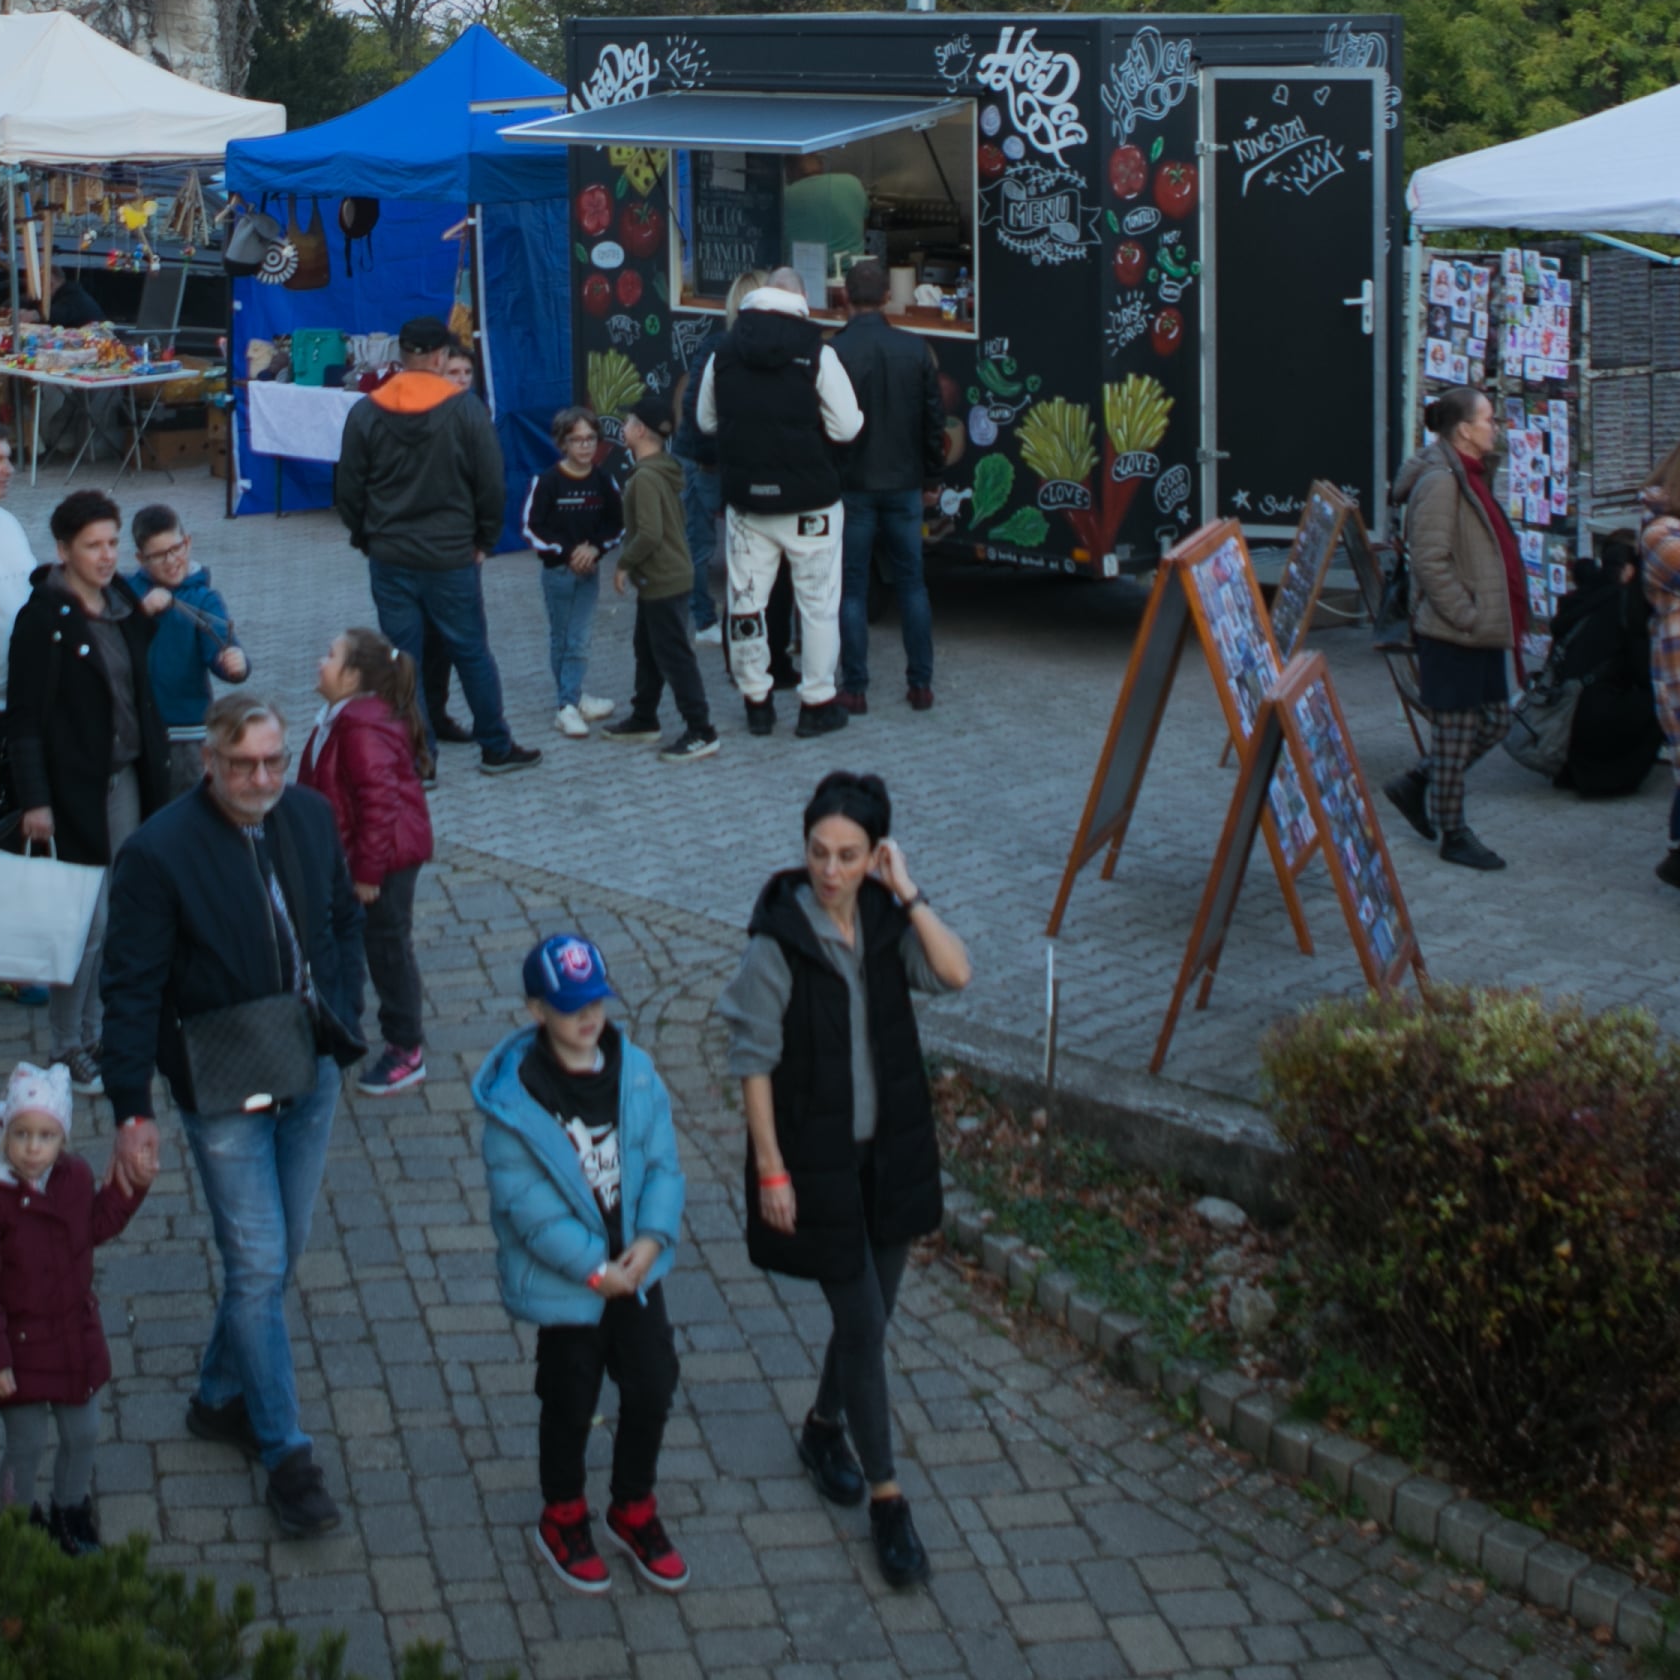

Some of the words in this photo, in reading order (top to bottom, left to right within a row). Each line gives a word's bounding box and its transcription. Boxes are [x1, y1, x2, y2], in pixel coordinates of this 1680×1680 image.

[1008, 195, 1071, 228] MENU
[1119, 455, 1153, 476] LOVE
[1048, 485, 1084, 506] LOVE
